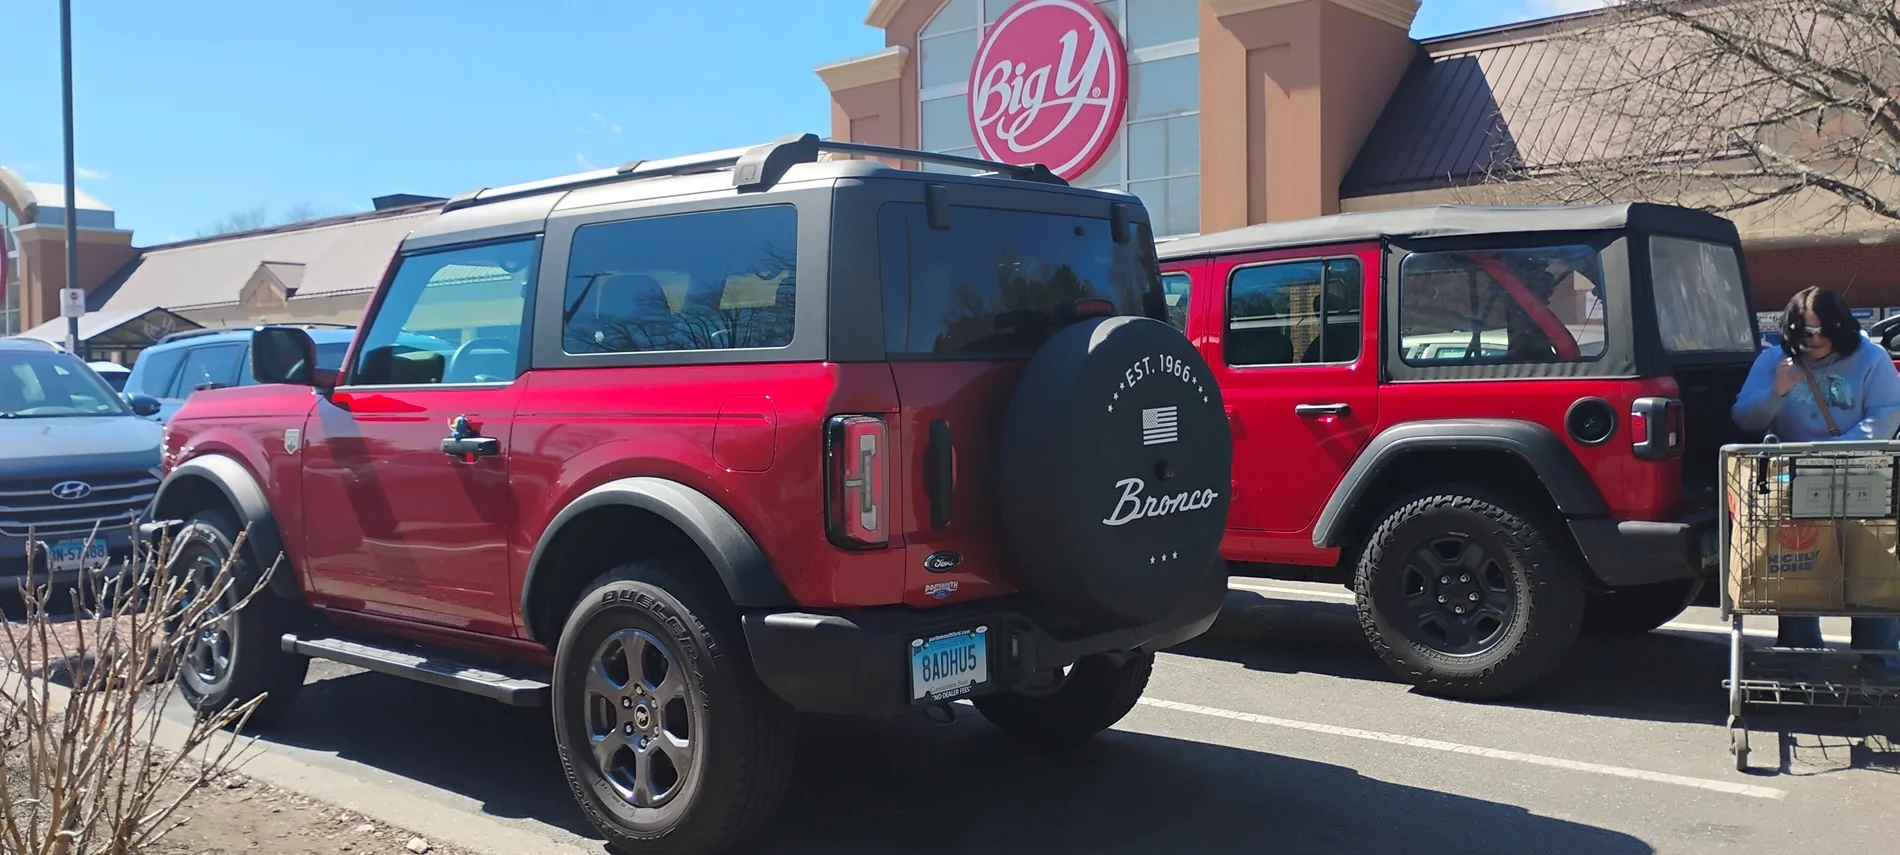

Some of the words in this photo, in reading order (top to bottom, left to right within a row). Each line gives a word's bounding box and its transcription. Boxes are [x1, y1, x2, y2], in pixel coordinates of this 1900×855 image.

[975, 59, 1053, 140] Big
[1125, 356, 1155, 388] EST.
[1159, 354, 1191, 382] 1966
[1102, 477, 1219, 526] Bronco
[934, 556, 955, 568] Ford
[600, 589, 698, 664] DUELER
[930, 638, 966, 650] Connecticut
[922, 644, 977, 682] 8ADHU5
[930, 681, 957, 693] Constitution
[942, 688, 959, 699] DEALER
